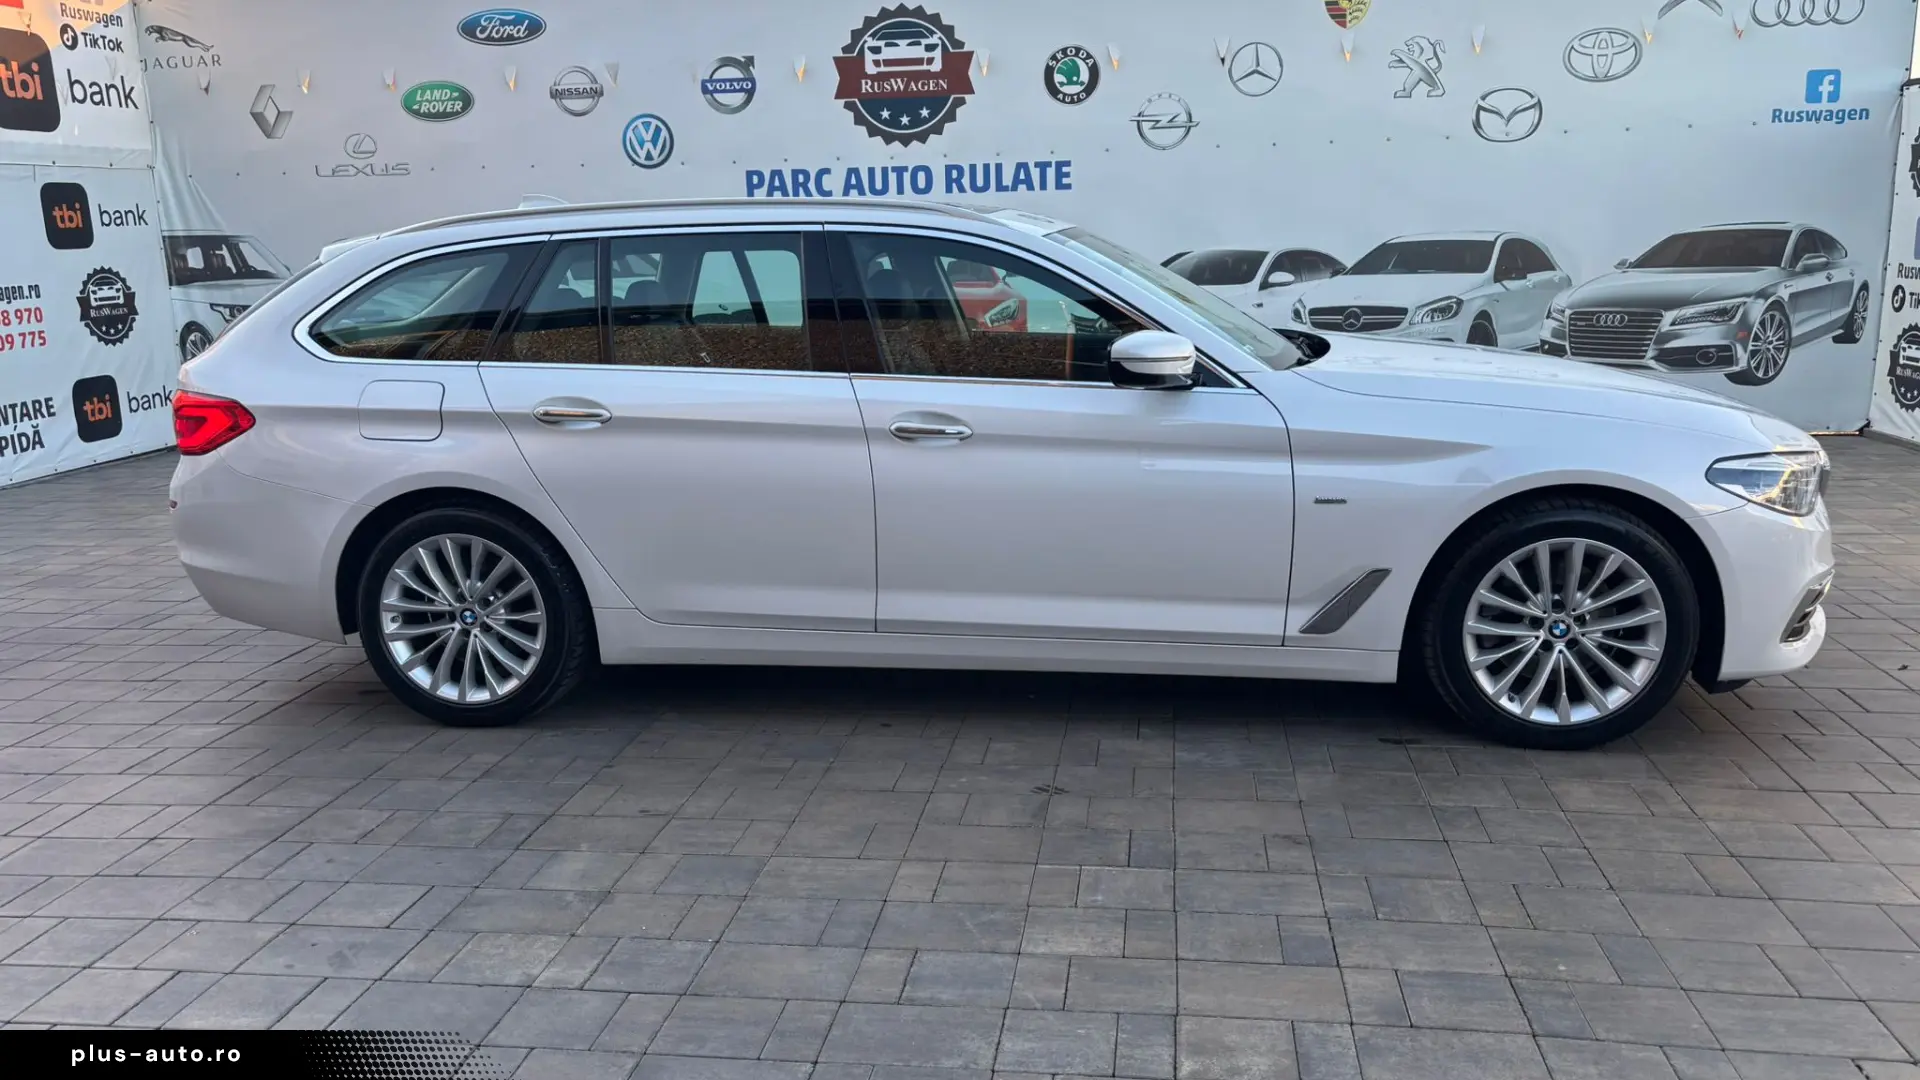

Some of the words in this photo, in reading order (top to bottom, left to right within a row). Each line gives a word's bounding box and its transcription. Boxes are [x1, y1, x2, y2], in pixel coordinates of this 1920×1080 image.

[59, 2, 124, 28] Ruswagen
[475, 14, 529, 39] Ford
[80, 31, 124, 53] TikTok
[141, 53, 222, 73] JAGUAR
[0, 60, 44, 101] tbi
[66, 68, 139, 110] bank
[416, 89, 451, 101] LAND
[554, 86, 599, 96] NISSAN
[705, 81, 752, 91] VOLVO
[420, 101, 463, 113] ROVER
[1057, 92, 1087, 102] AUTO
[1771, 108, 1870, 125] Ruswagen
[314, 163, 411, 178] LEXUS
[745, 168, 833, 198] PARC
[842, 164, 934, 196] AUTO
[944, 160, 1073, 194] RULATE
[52, 202, 83, 228] tbi
[98, 203, 149, 227] bank
[14, 306, 43, 326] 970
[18, 329, 47, 350] 775
[83, 393, 113, 422] tbi
[127, 385, 173, 413] bank
